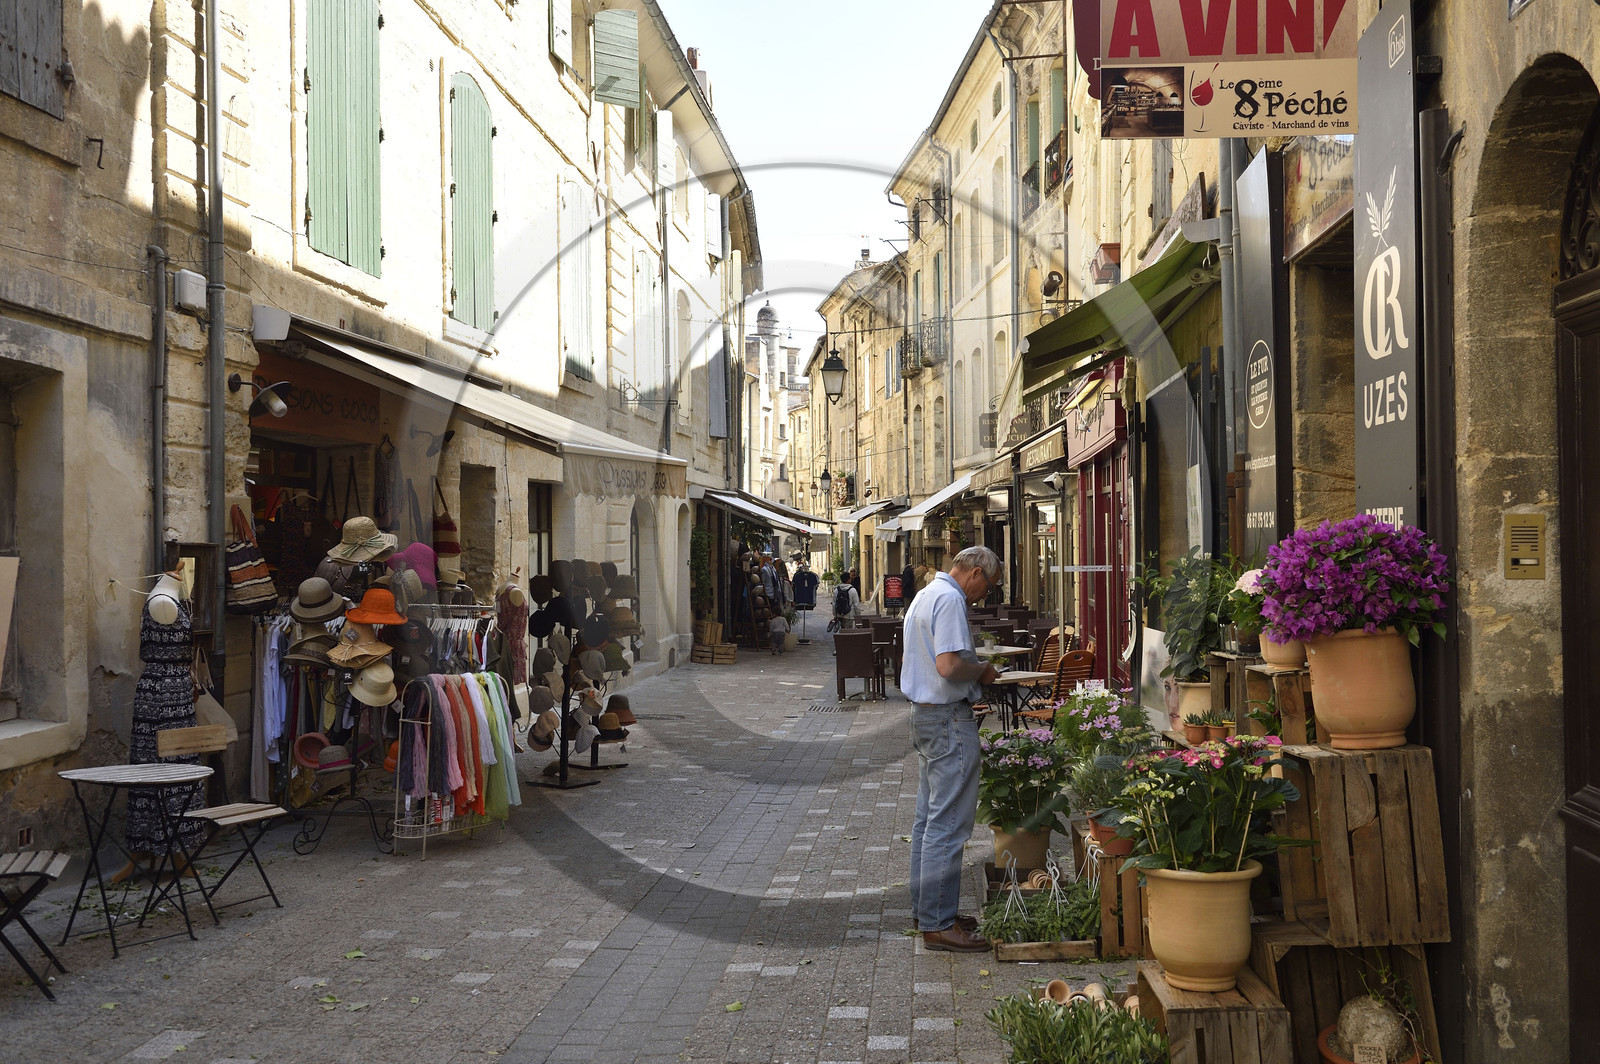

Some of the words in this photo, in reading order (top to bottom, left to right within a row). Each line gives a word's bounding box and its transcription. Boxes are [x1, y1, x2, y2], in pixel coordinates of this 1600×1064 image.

[1219, 79, 1235, 90] Le
[1262, 89, 1348, 118] Péché
[1232, 120, 1265, 131] Caviste
[1272, 119, 1316, 130] Marchand
[1318, 119, 1328, 129] de
[1330, 118, 1349, 129] vins
[1363, 370, 1408, 429] UZES
[982, 417, 1029, 425] RESTANT
